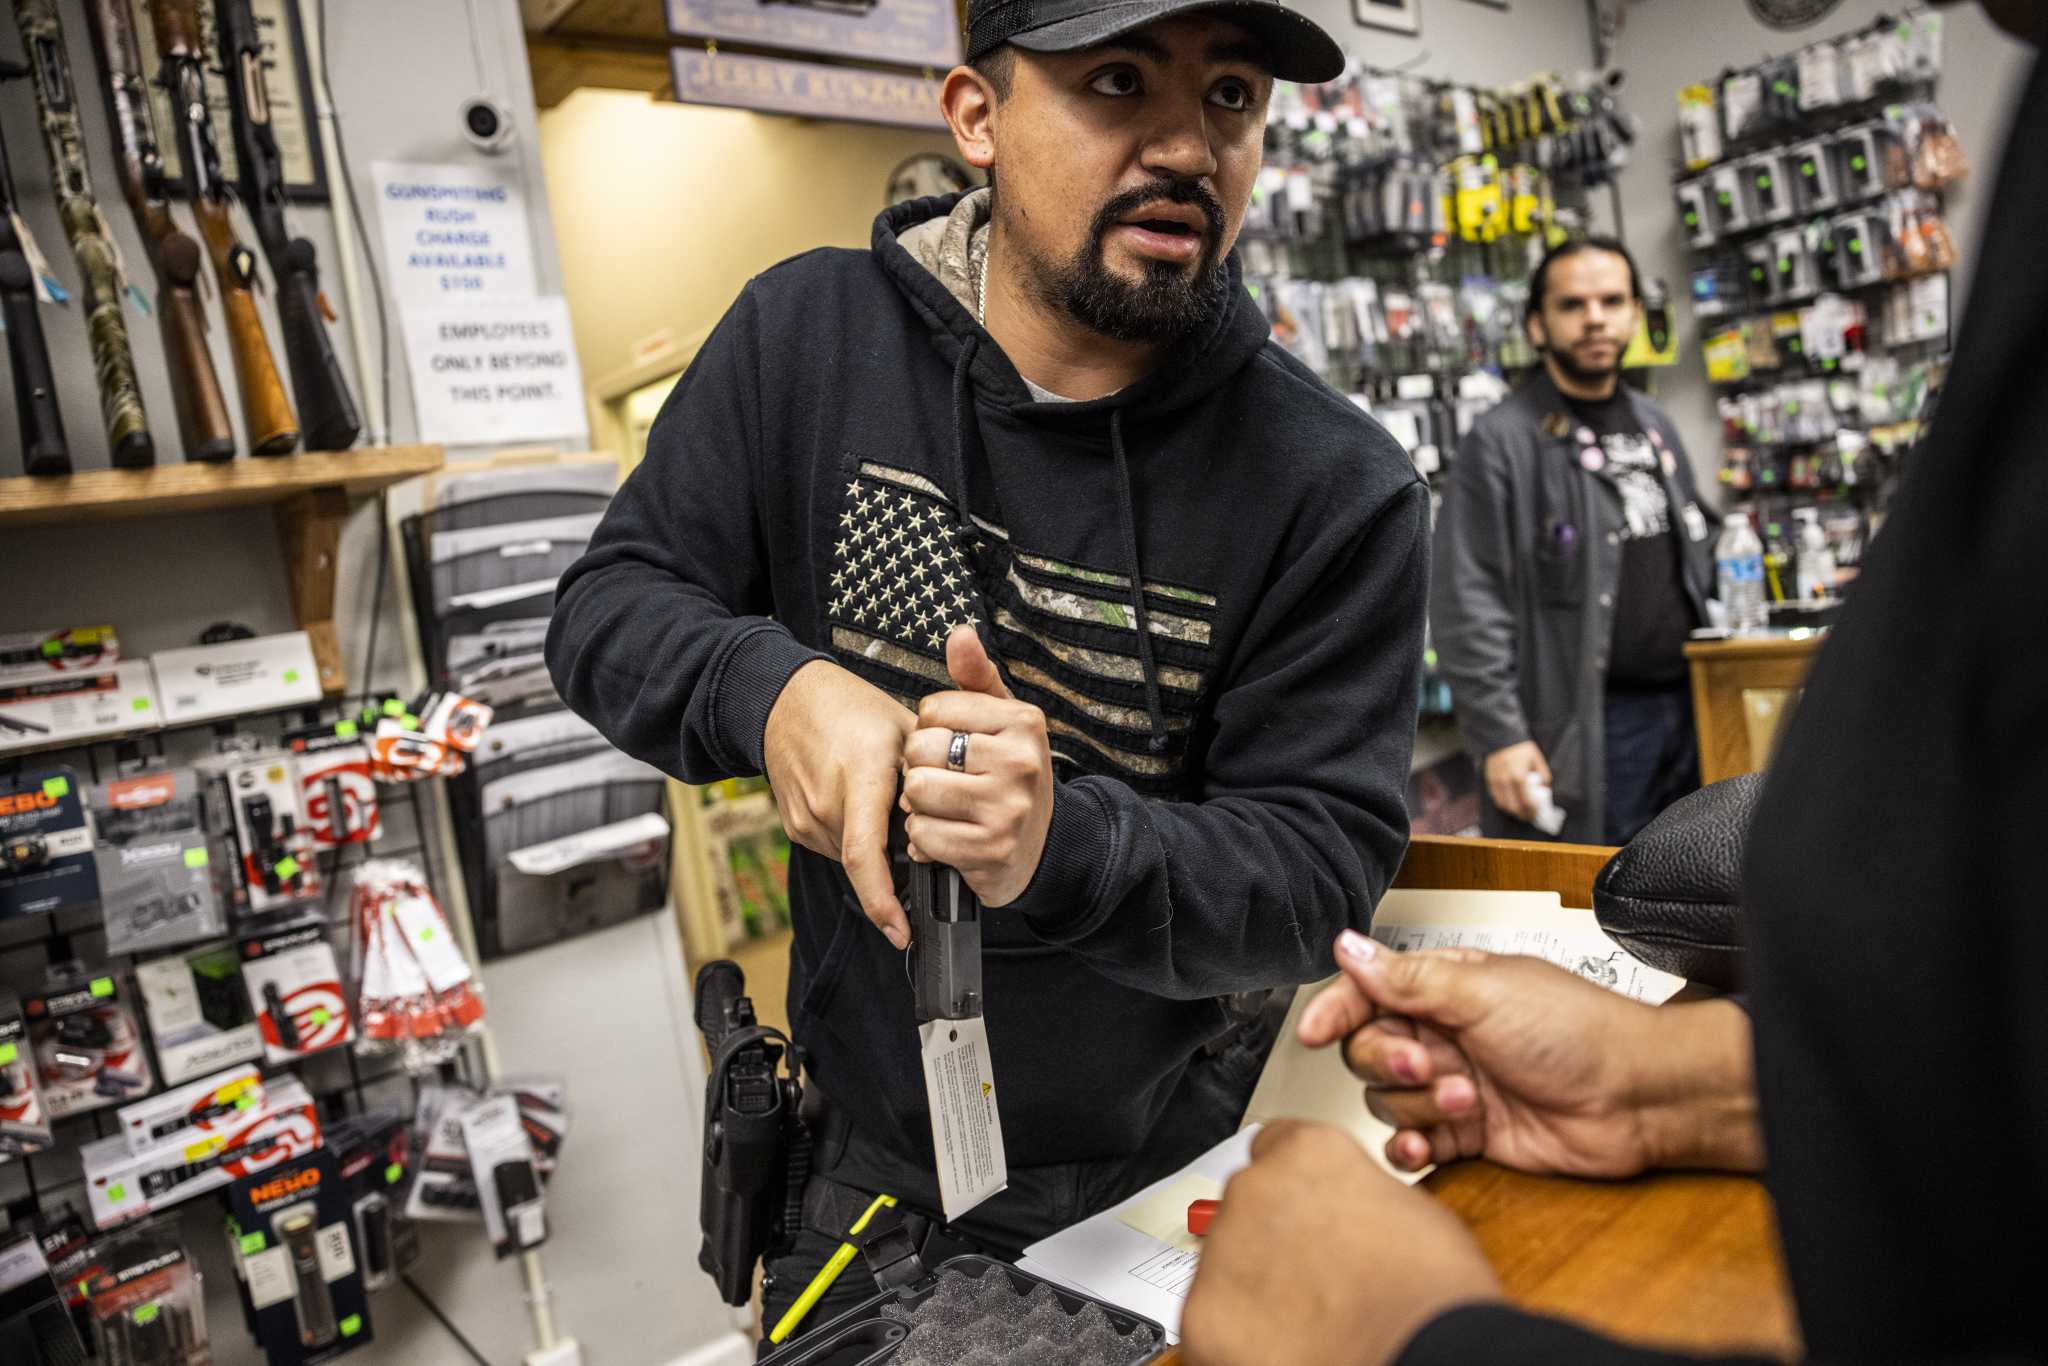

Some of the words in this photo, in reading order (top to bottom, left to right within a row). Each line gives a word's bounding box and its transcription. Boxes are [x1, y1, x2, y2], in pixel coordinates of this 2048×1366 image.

[814, 71, 942, 109] KUSZMA
[385, 183, 507, 202] GUNSMITHING
[425, 208, 475, 223] RUSH
[416, 230, 490, 246] CHARGE
[408, 253, 505, 268] AVAILABLE
[438, 322, 551, 341] EMPLOYEES
[431, 353, 483, 373] ONLY
[489, 351, 567, 370] BEYOND
[450, 385, 491, 403] THIS
